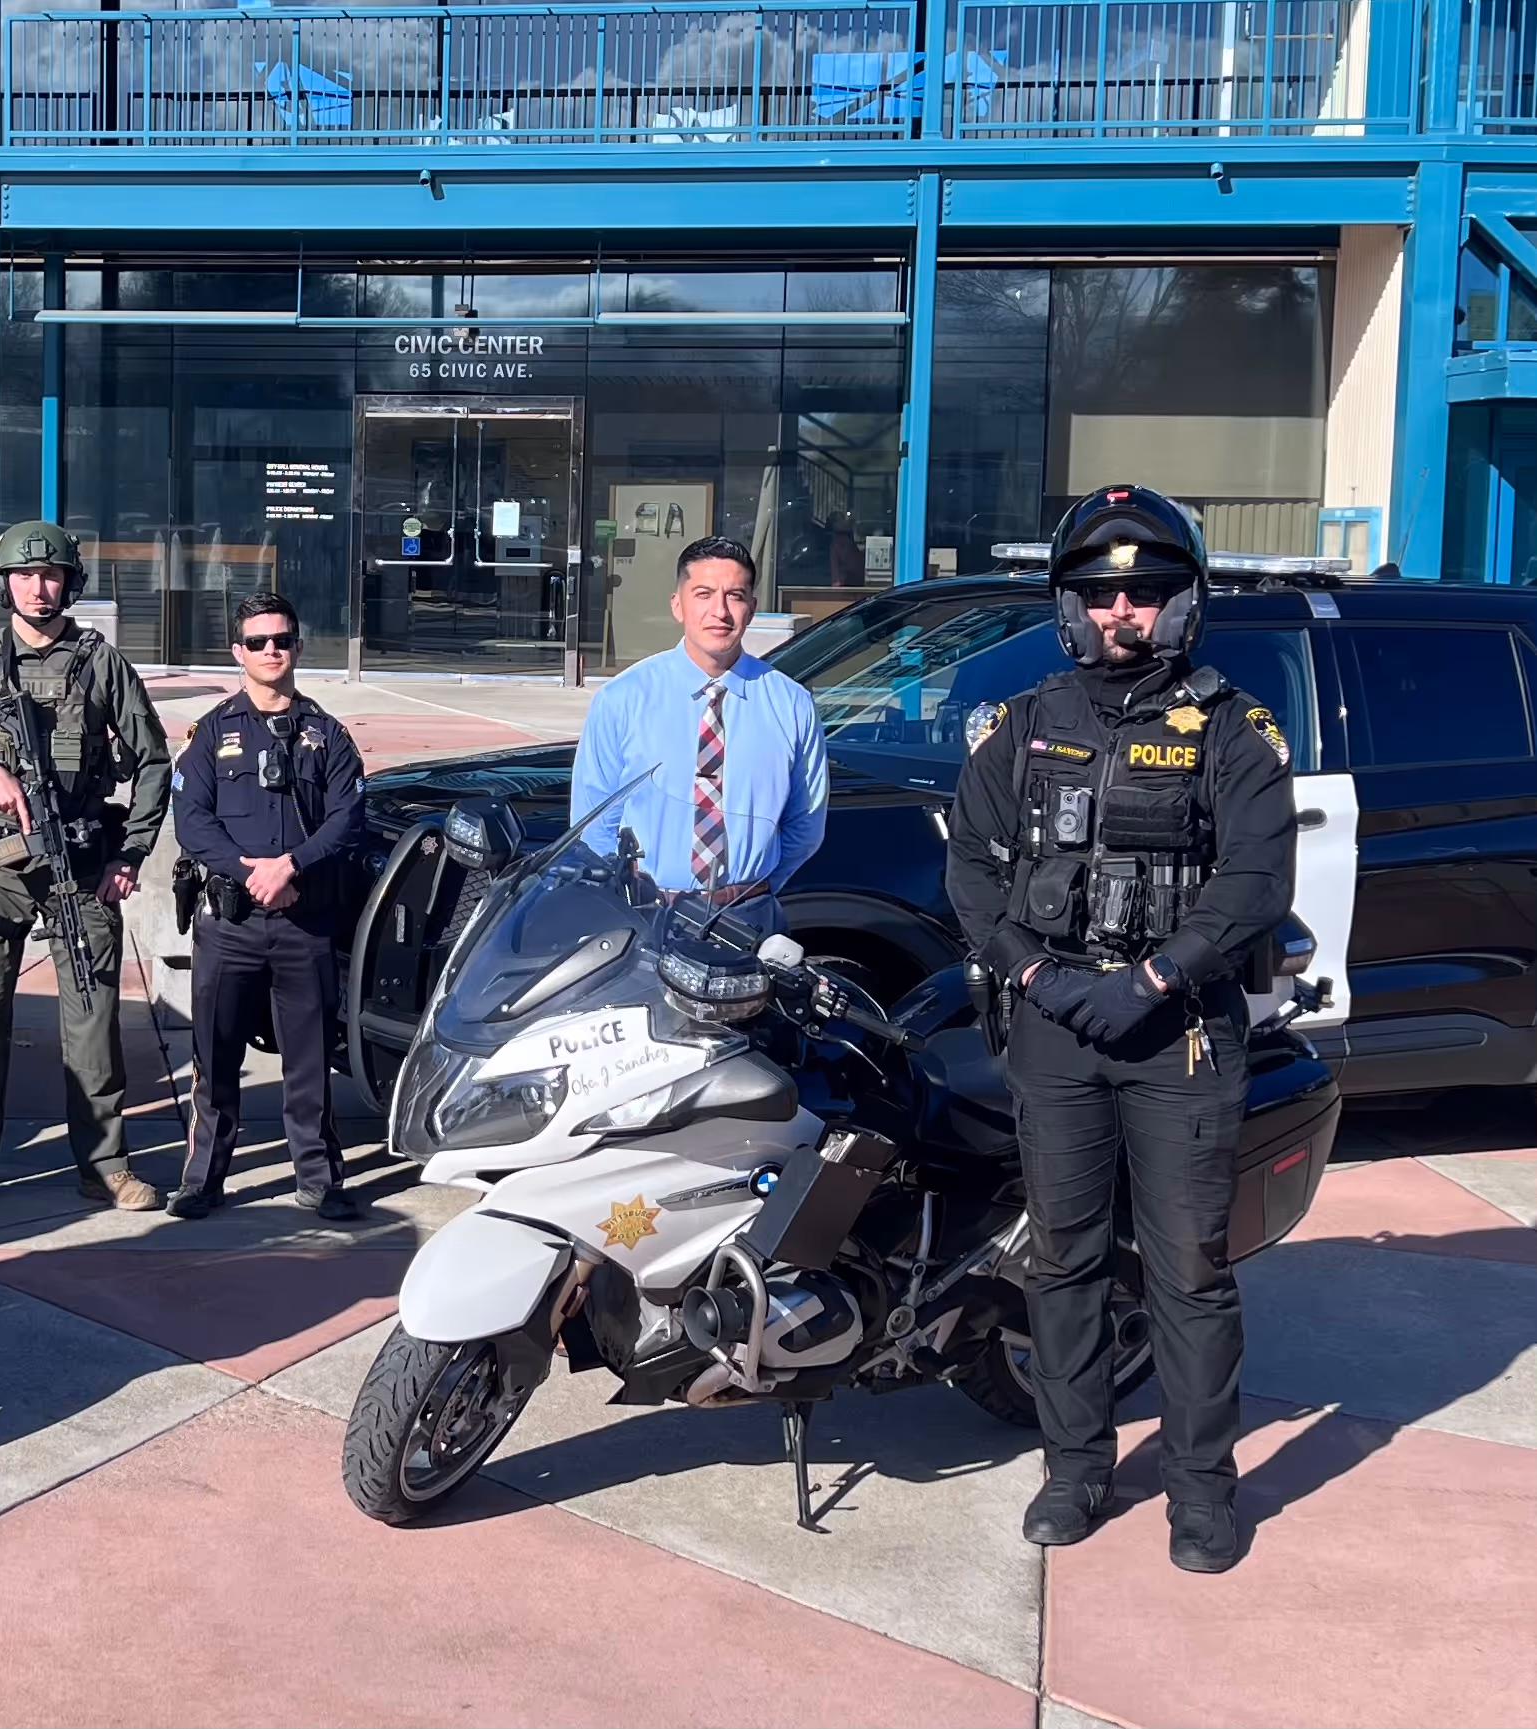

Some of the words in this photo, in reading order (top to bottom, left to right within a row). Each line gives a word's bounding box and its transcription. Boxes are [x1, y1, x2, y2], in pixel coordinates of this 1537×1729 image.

[394, 335, 453, 354] CIVIC
[458, 335, 544, 355] CENTER
[409, 363, 432, 378] 65
[438, 363, 487, 378] CIVIC
[493, 363, 533, 378] AVE.
[22, 681, 63, 696] OLICE
[1129, 743, 1197, 767] POLICE
[605, 1209, 653, 1230] PITTSBURG
[610, 1225, 650, 1239] POLICE
